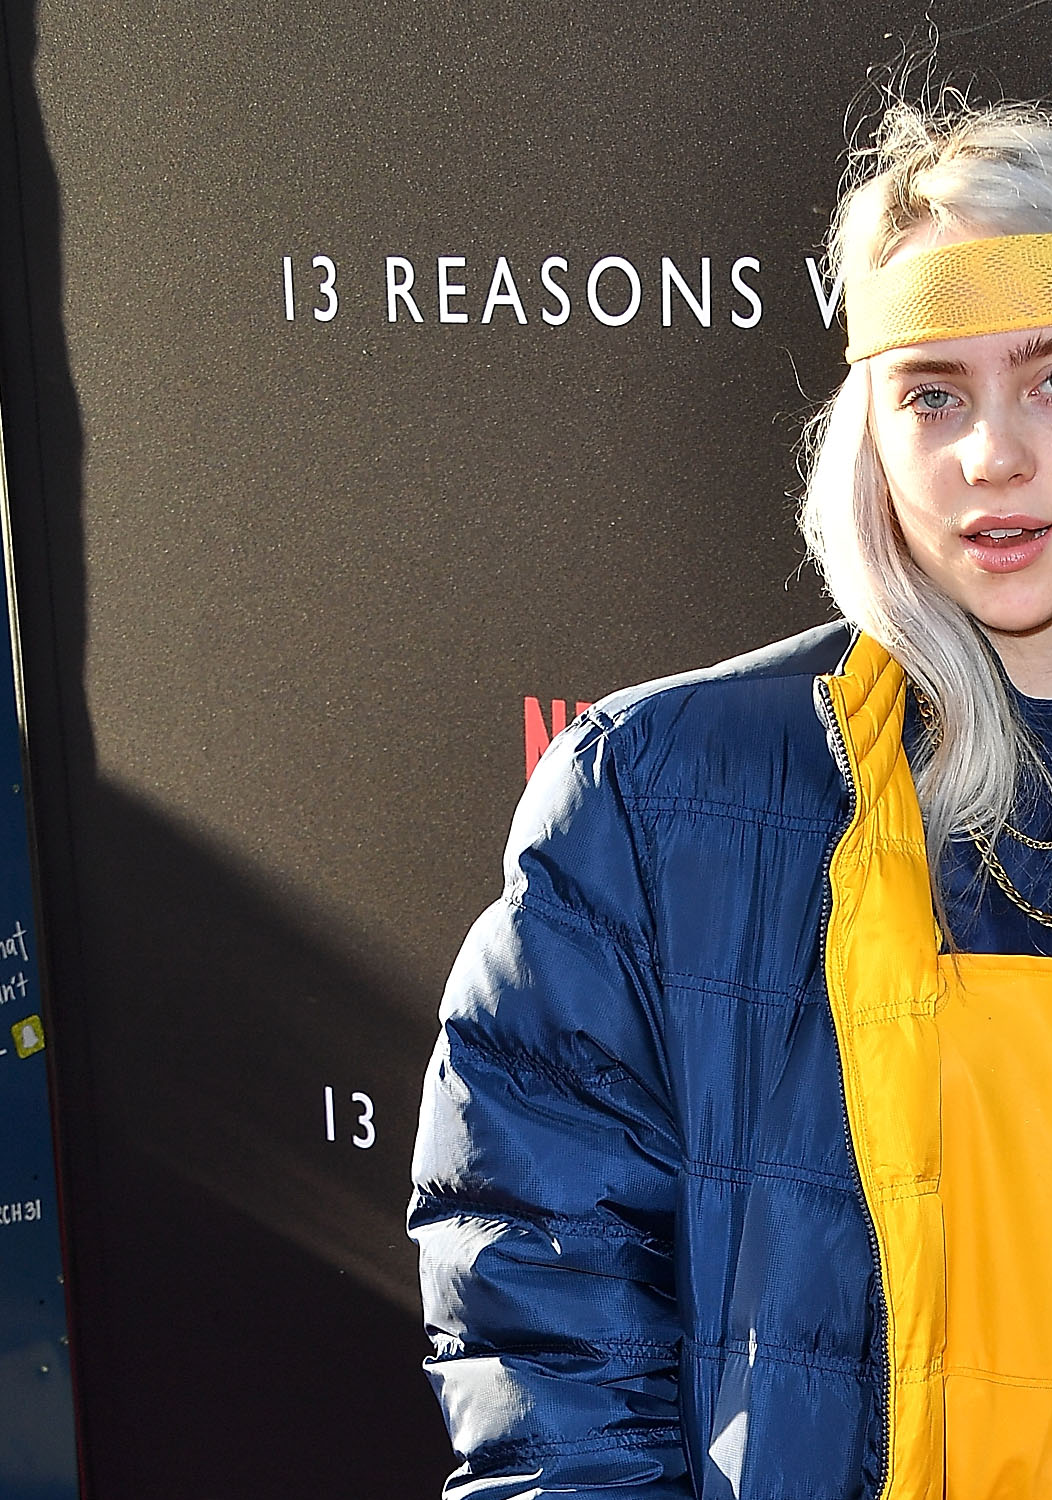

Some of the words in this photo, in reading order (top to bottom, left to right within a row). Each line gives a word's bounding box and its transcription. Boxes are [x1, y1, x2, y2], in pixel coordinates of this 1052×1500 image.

[283, 255, 338, 322] 13
[386, 256, 762, 328] REASONS
[325, 1086, 376, 1149] 13
